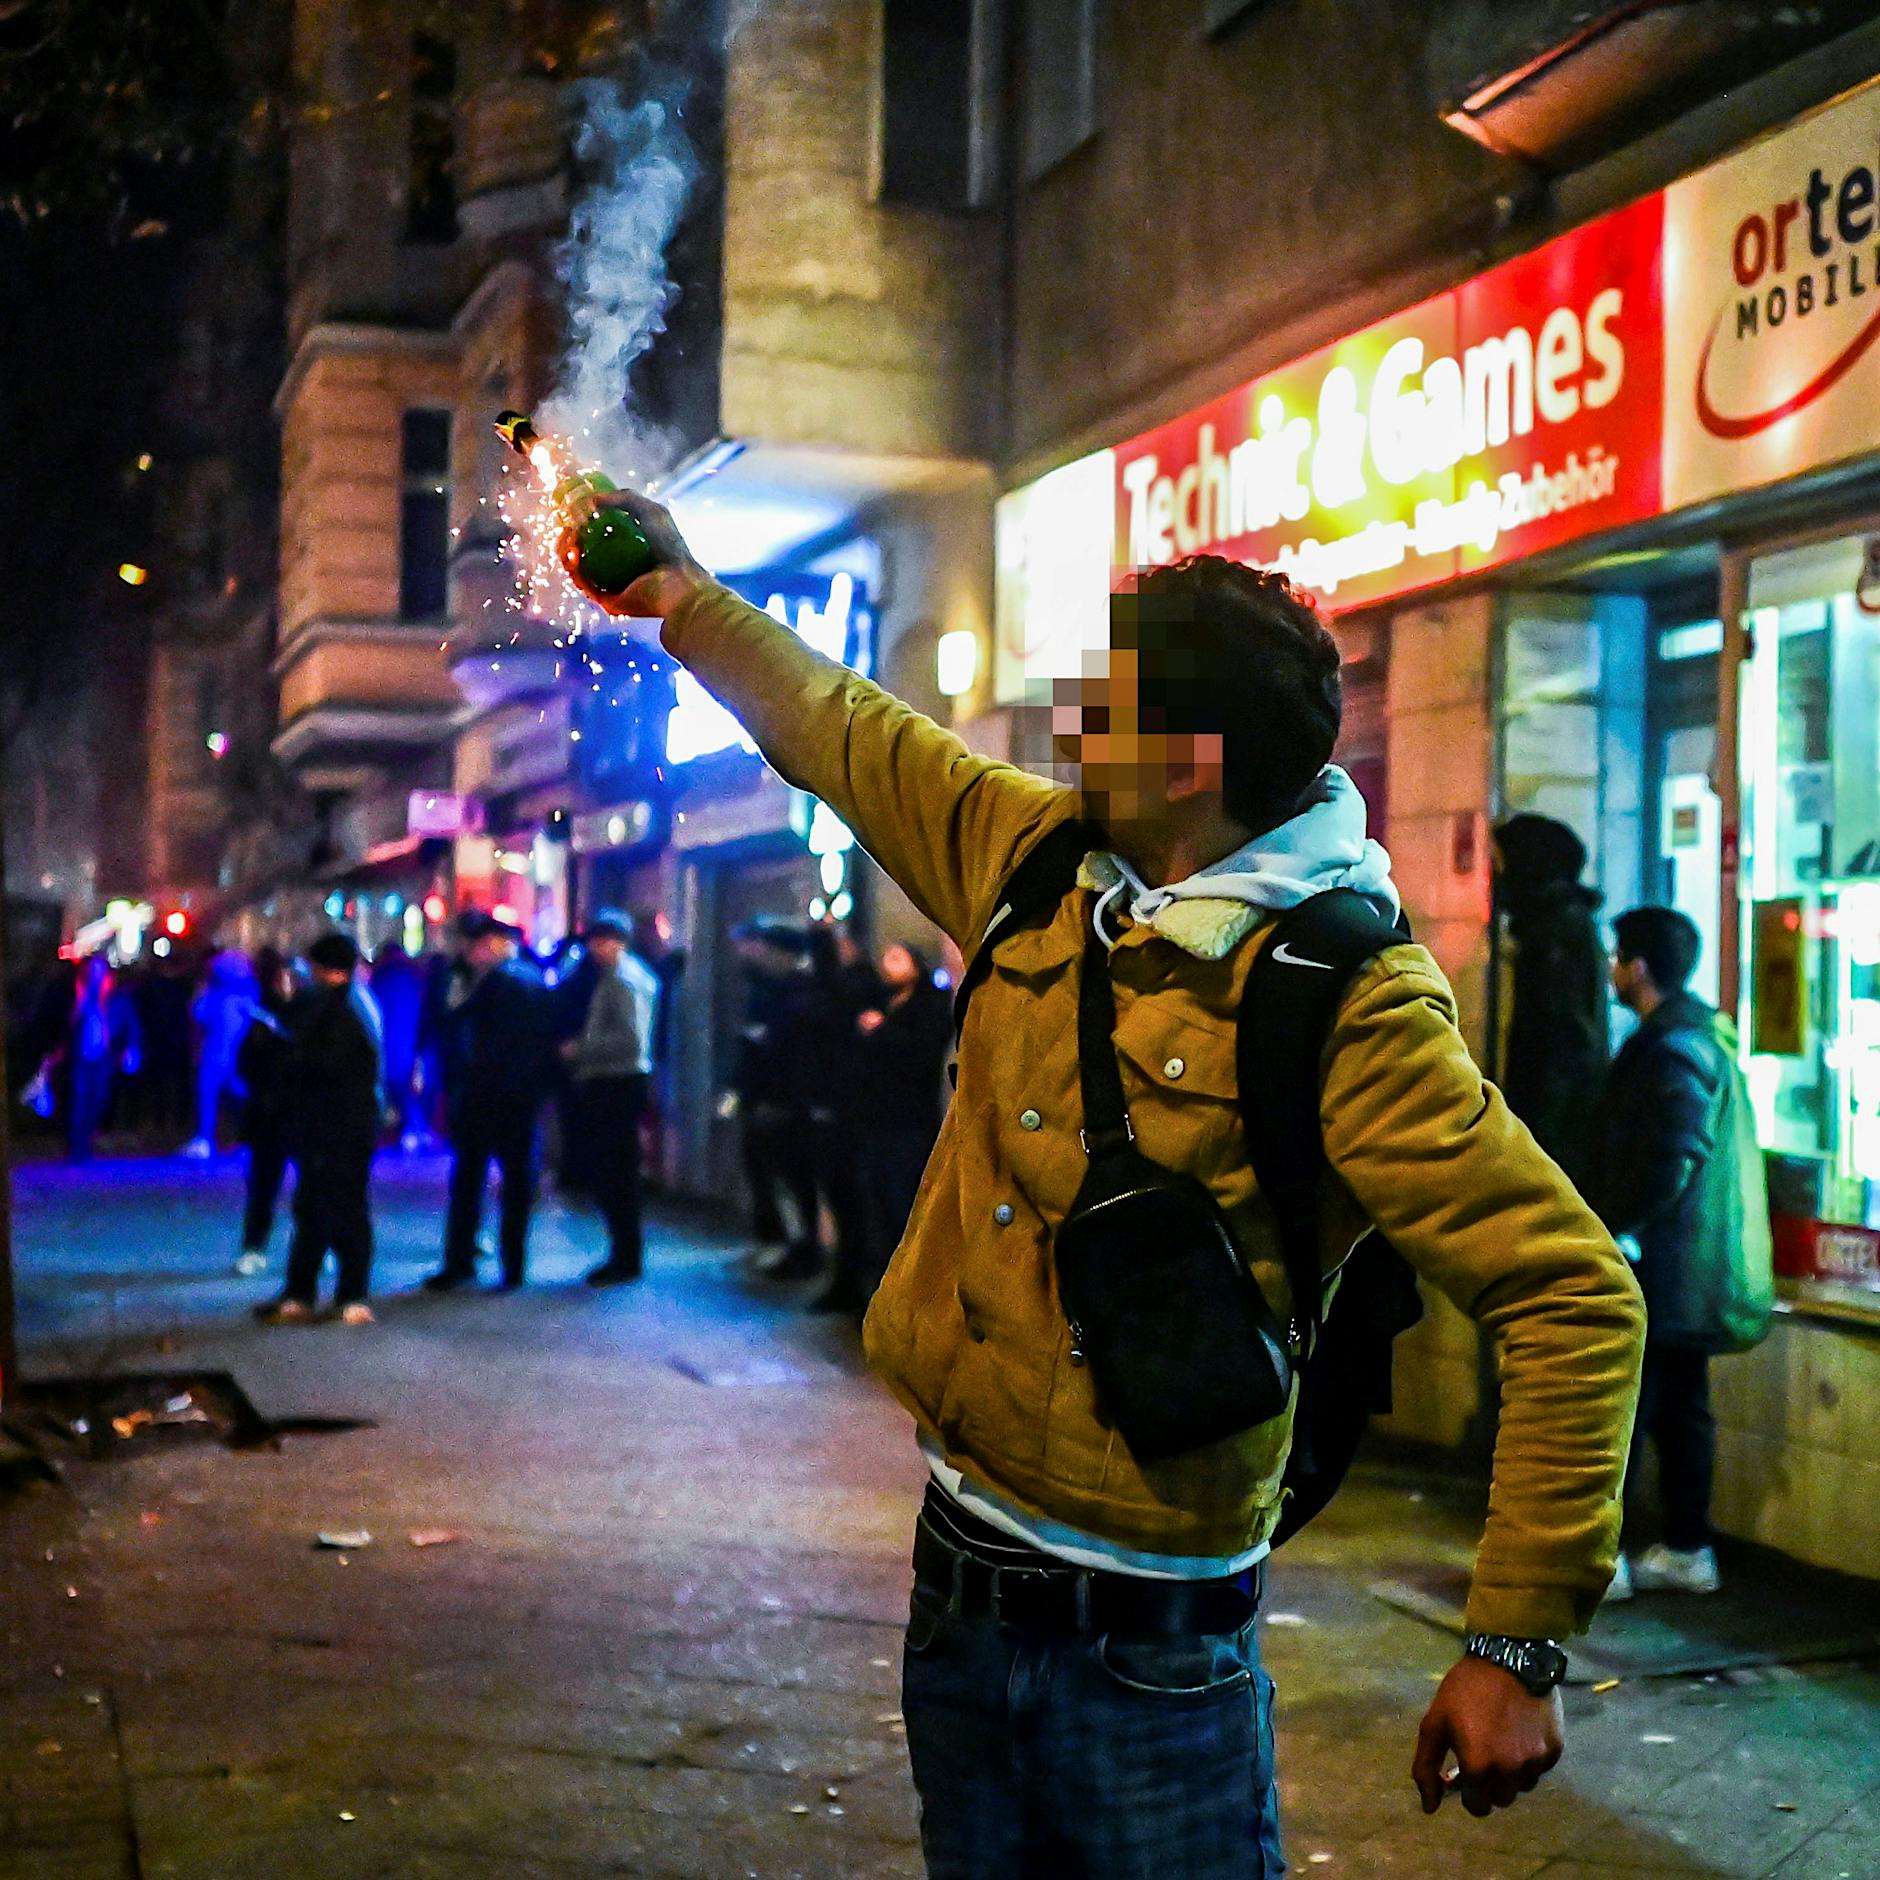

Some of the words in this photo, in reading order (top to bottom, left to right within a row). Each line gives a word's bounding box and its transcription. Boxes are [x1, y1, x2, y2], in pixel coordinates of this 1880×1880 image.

[1733, 165, 1880, 287] orte
[1123, 394, 1311, 568] Technic
[1312, 366, 1367, 508] &
[1369, 288, 1624, 485] Games
